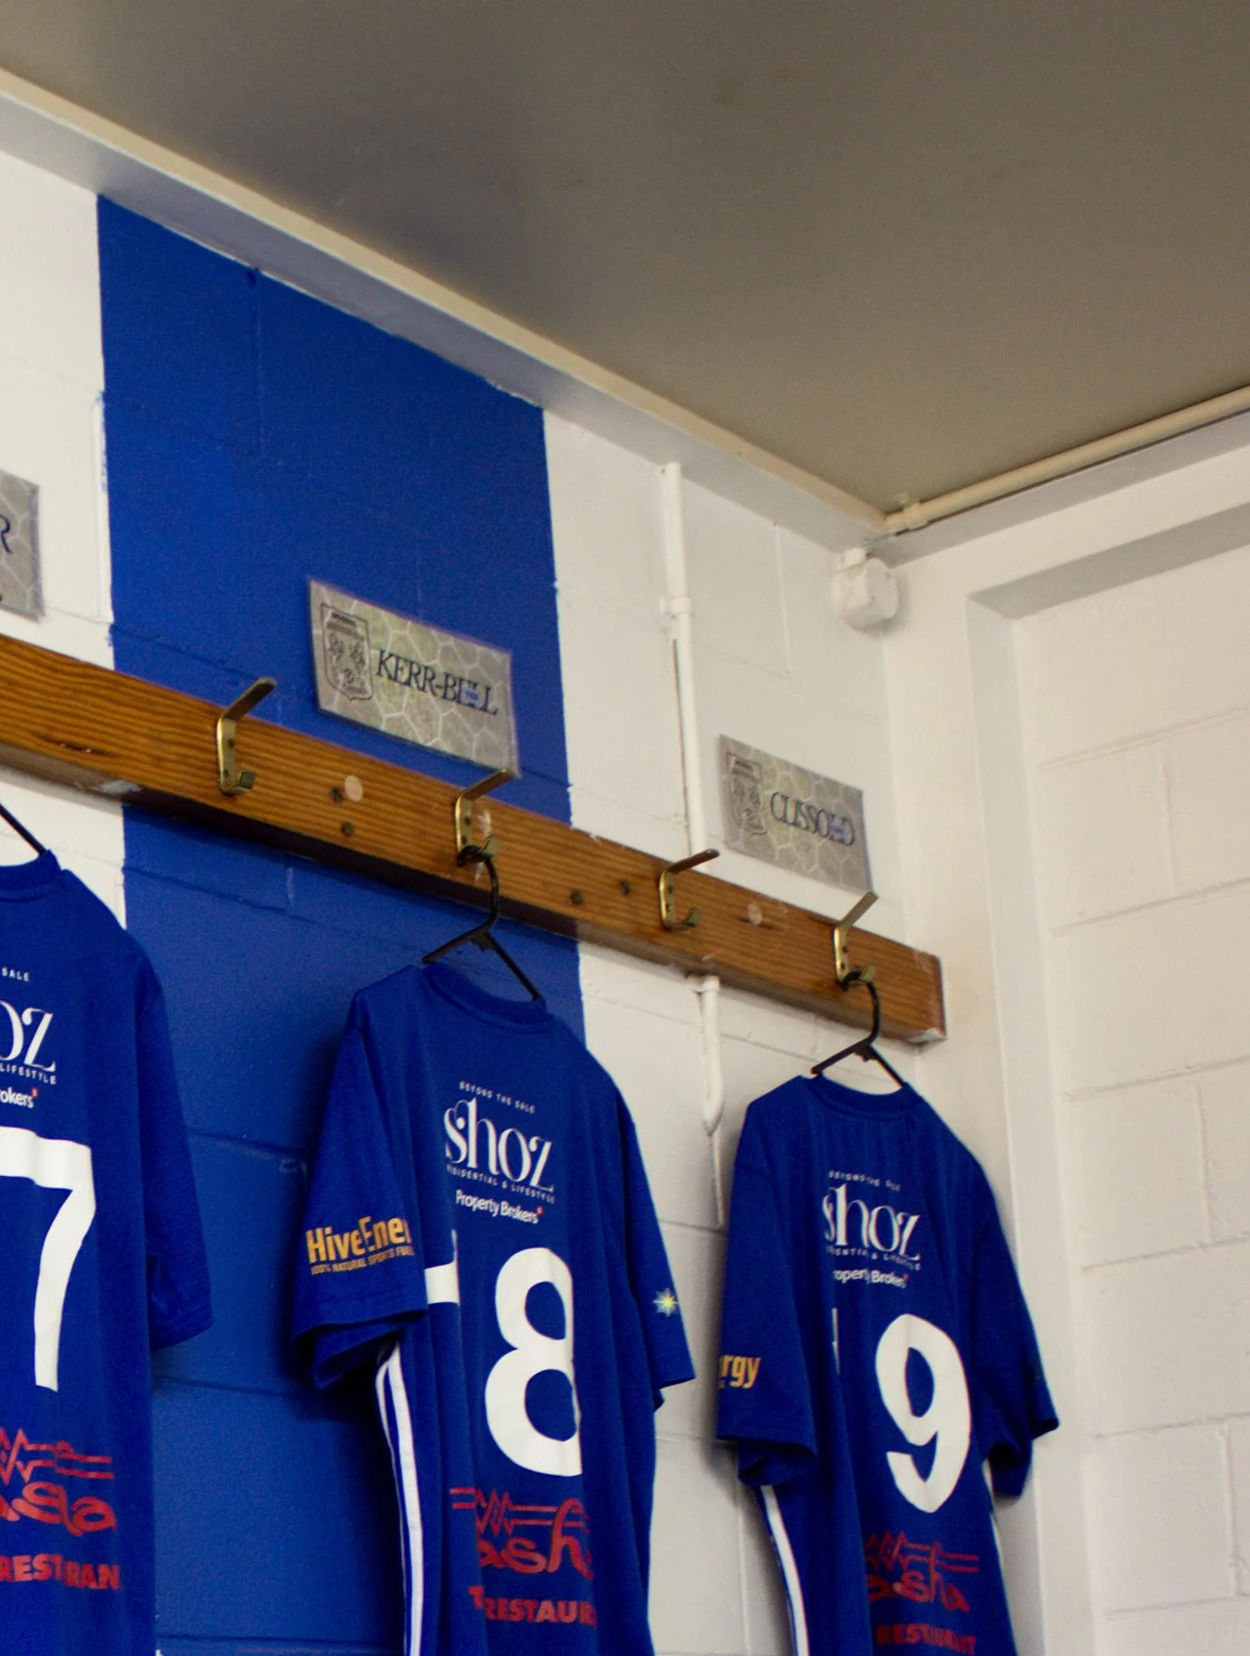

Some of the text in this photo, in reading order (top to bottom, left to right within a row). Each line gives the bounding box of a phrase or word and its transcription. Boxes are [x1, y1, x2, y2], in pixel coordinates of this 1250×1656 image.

[376, 649, 499, 716] KERR-BELL
[1, 967, 30, 982] SALE
[0, 1060, 57, 1085] LIFESTYLE
[443, 1097, 555, 1193] shoz
[455, 1188, 539, 1225] Property Brokers
[822, 1183, 920, 1261] shoz
